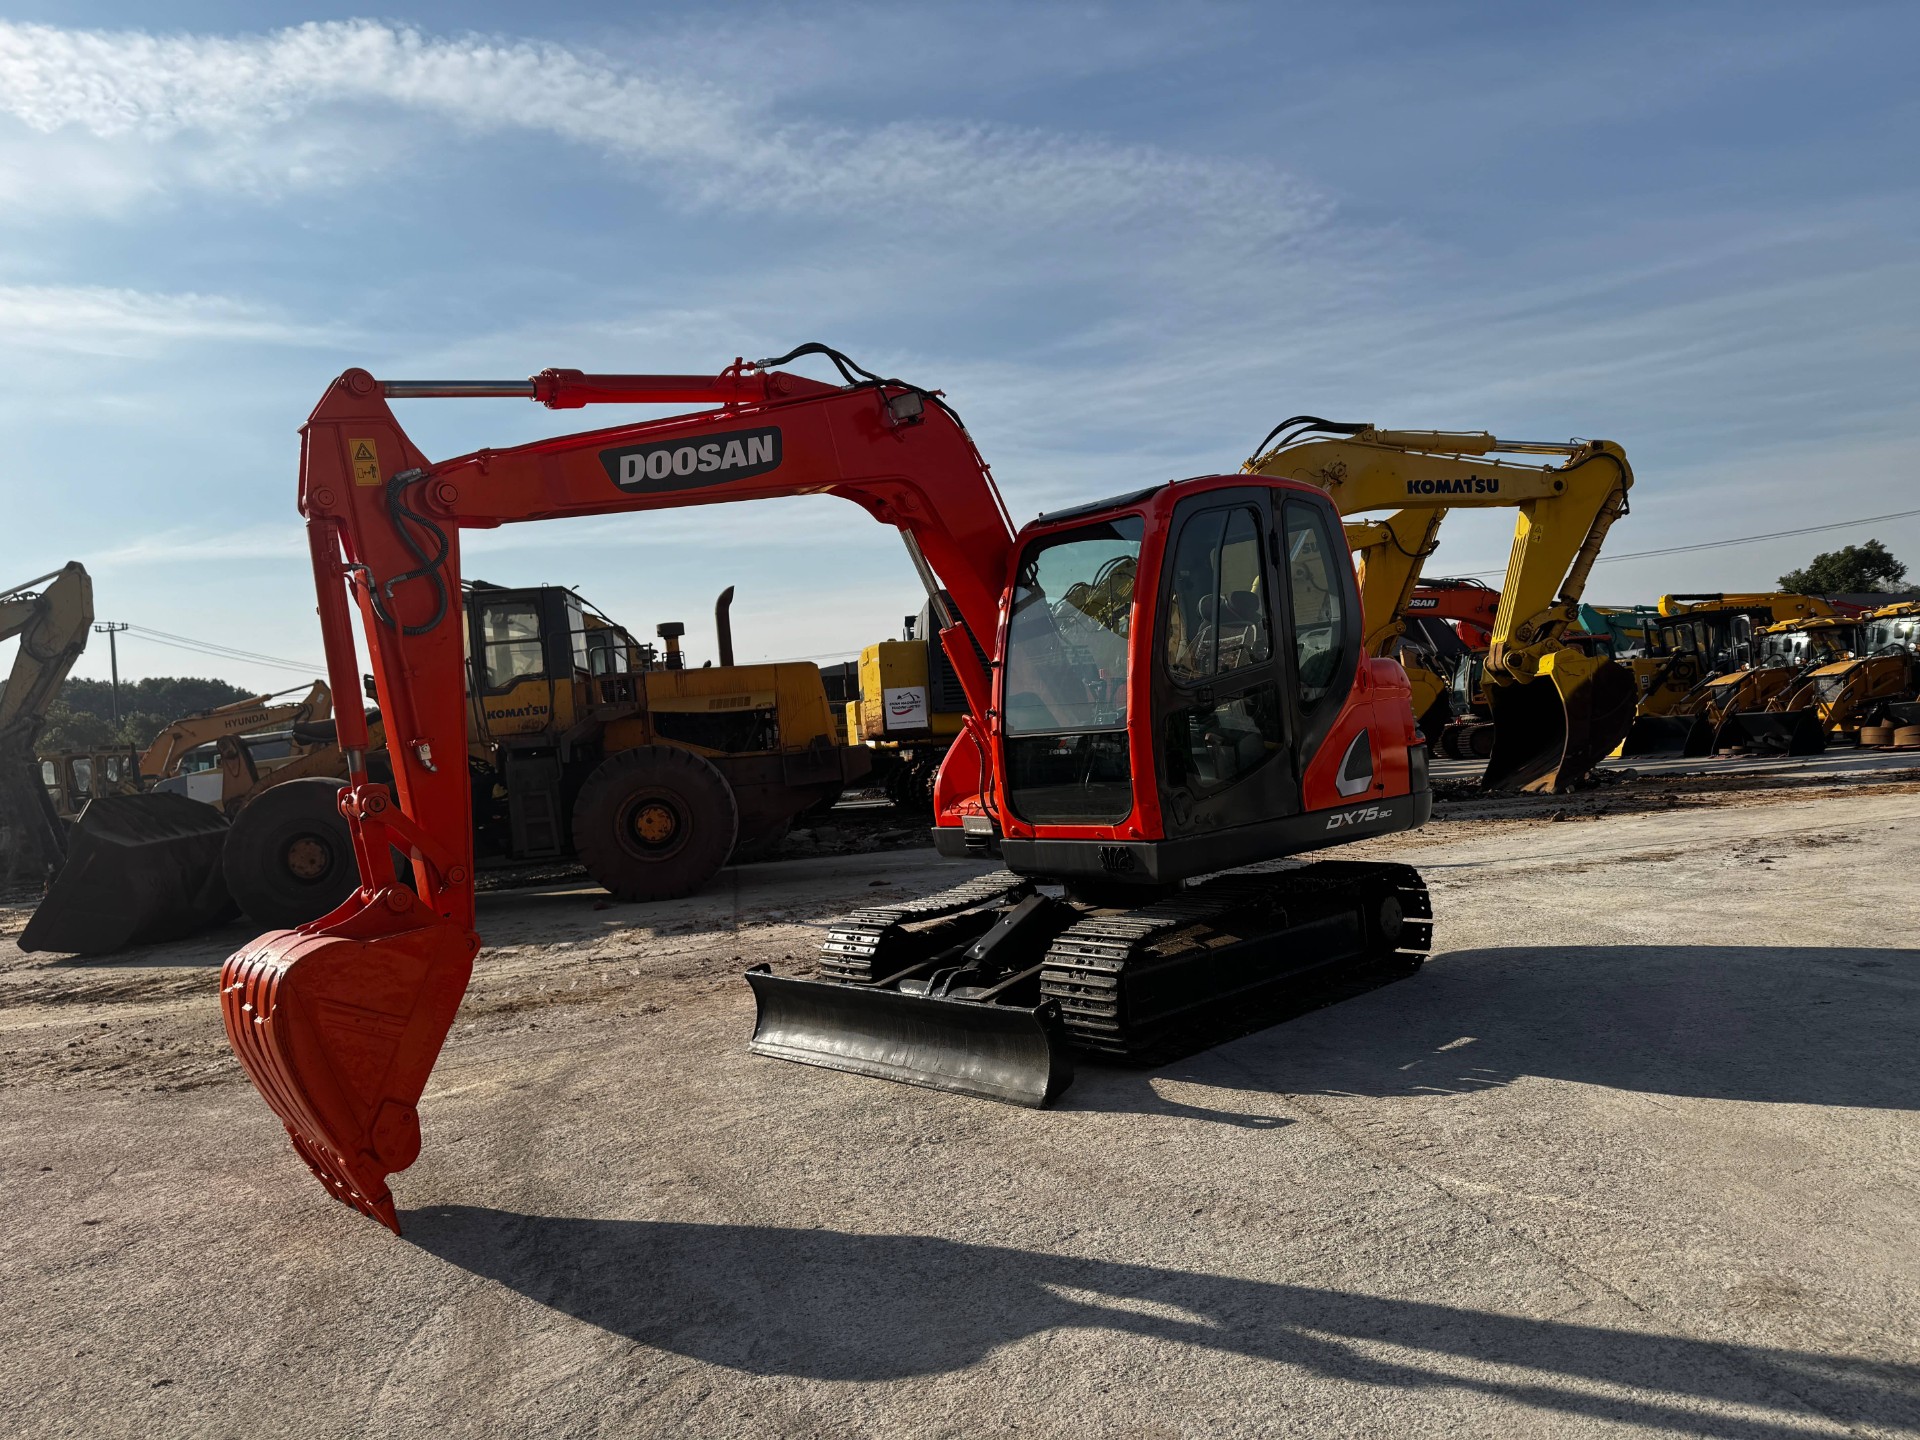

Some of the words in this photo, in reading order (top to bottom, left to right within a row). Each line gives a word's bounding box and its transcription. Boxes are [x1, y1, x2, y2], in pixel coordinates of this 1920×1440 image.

[619, 434, 774, 485] DOOSAN
[1407, 475, 1499, 494] KOMATSU
[1408, 599, 1436, 607] OSAN
[487, 703, 548, 720] KOMATSU
[224, 713, 269, 728] HYUNDAI
